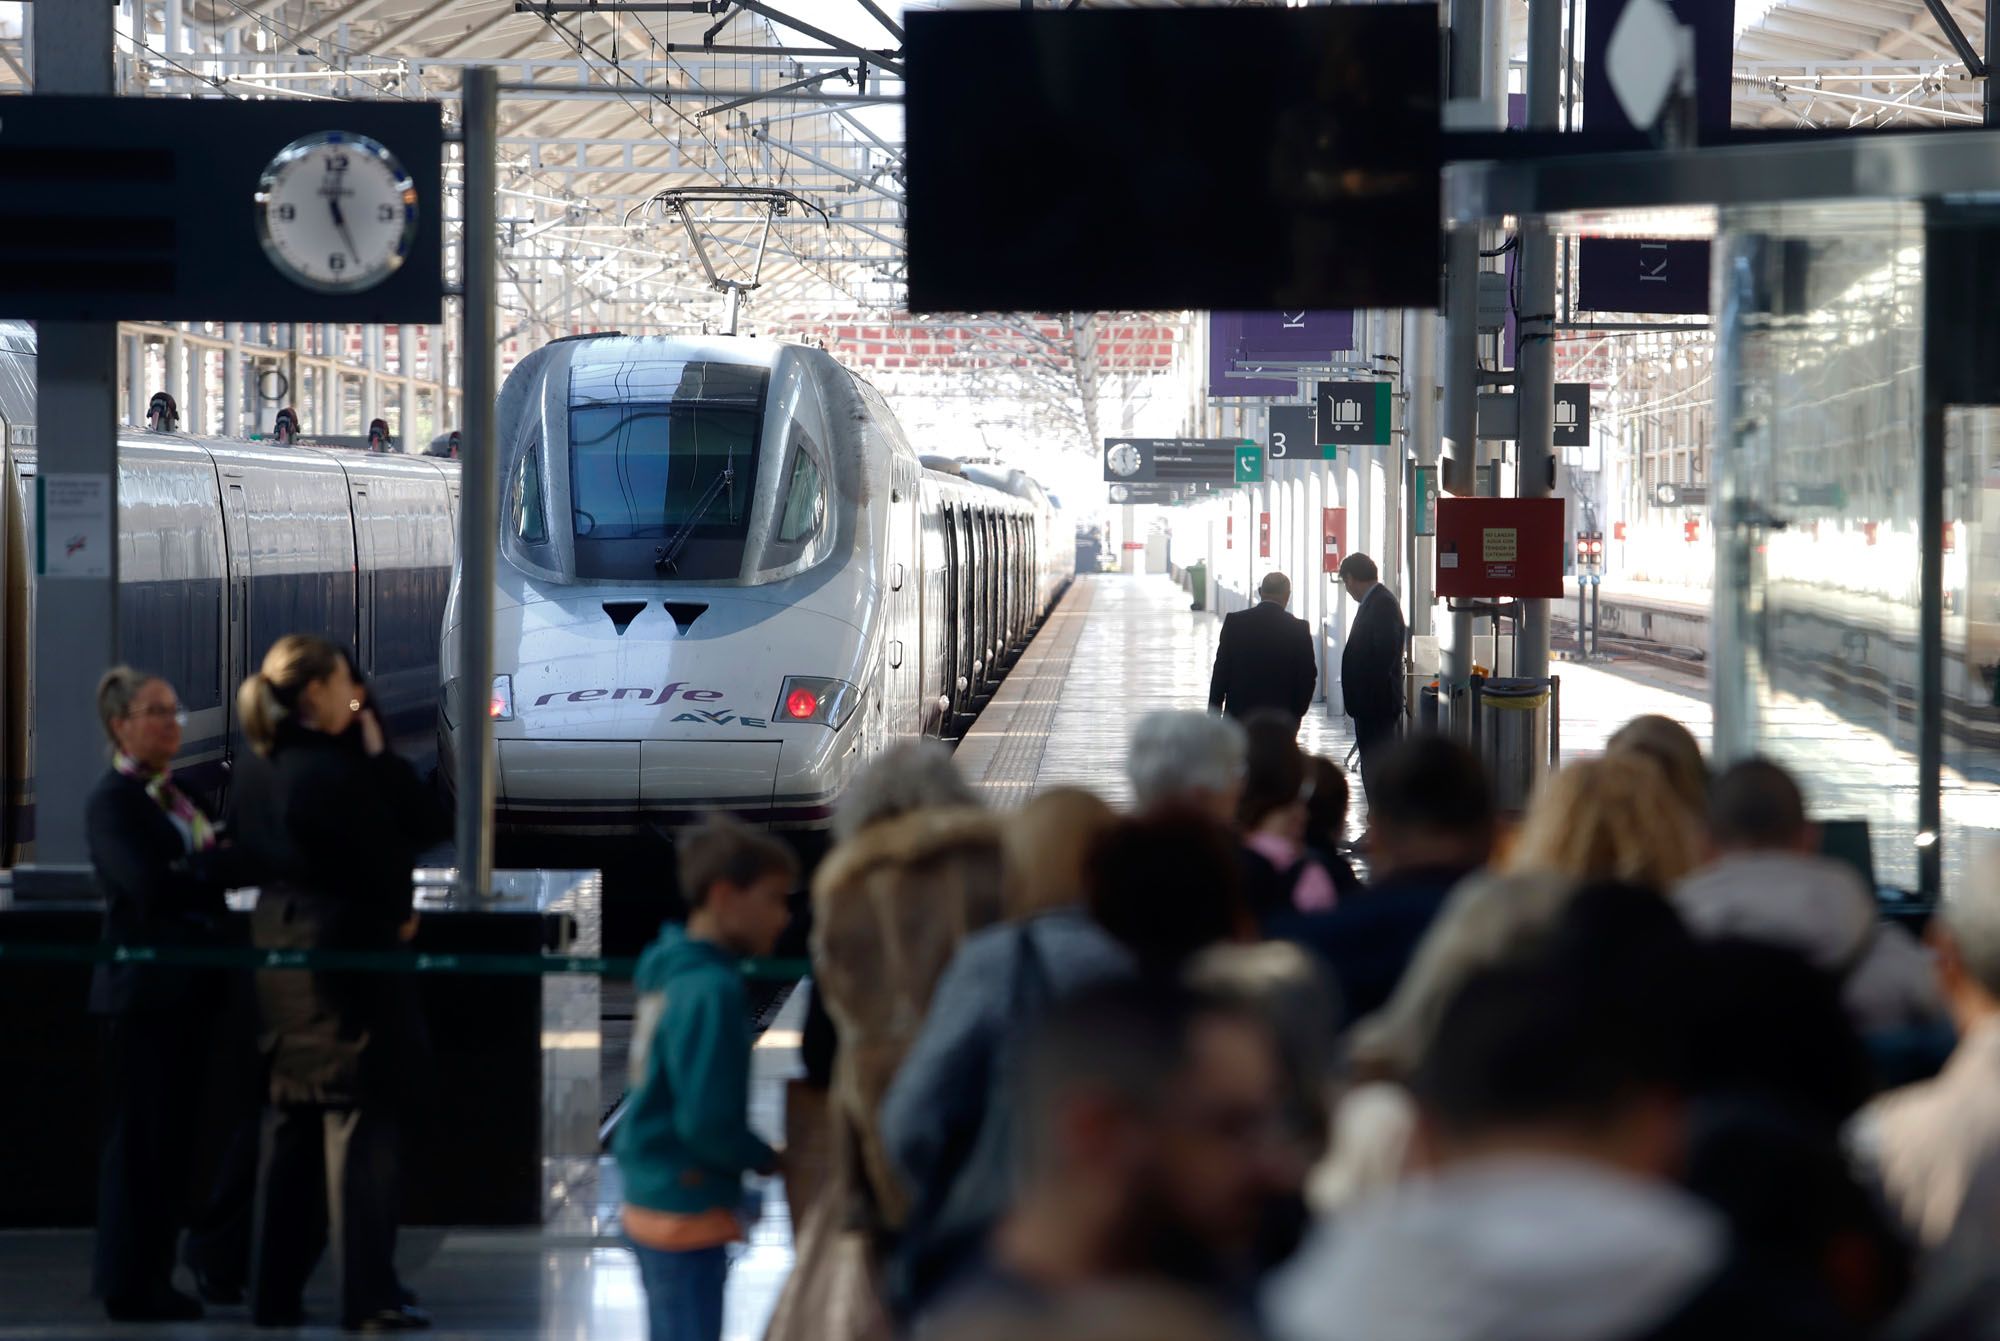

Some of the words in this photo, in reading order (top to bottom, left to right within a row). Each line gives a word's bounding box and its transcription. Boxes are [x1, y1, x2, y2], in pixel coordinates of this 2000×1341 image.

[326, 154, 348, 172] 12
[280, 203, 295, 221] 9
[379, 203, 394, 222] 3
[329, 253, 345, 271] 6
[1272, 432, 1287, 458] 3
[534, 681, 724, 706] renfe
[670, 708, 767, 728] AVE
